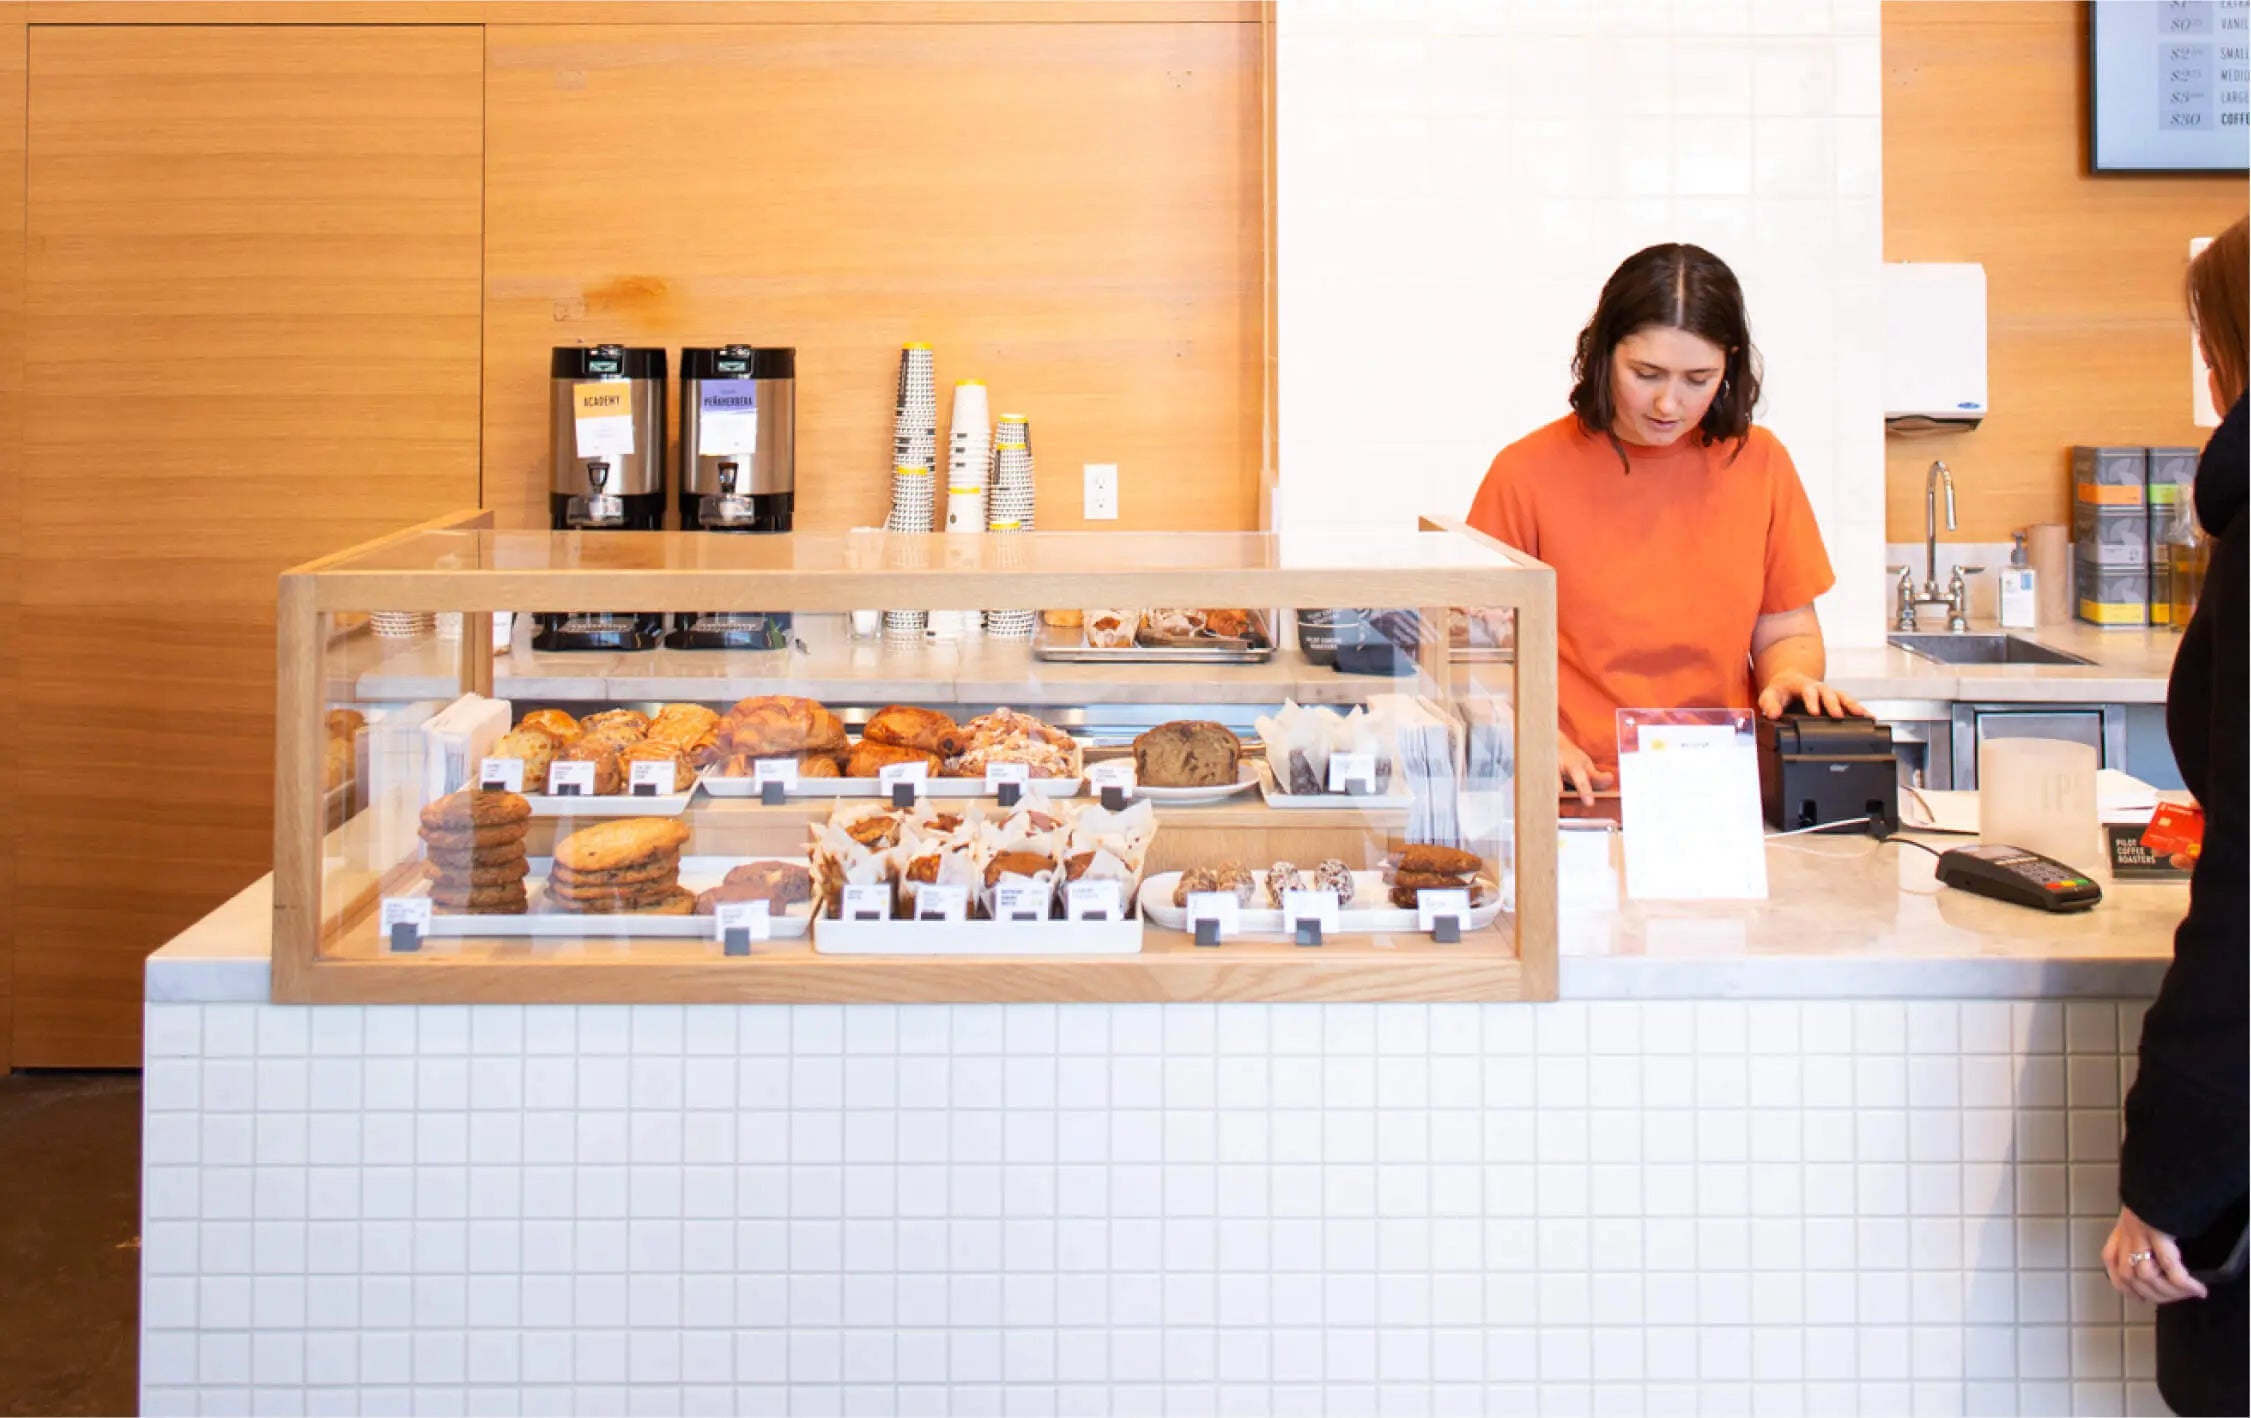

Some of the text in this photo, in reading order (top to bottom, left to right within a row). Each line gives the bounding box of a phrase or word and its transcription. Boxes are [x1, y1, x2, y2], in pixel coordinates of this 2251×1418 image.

[583, 395, 620, 407] ACADEMY
[2115, 838, 2137, 847] PILOT
[2117, 846, 2145, 857] COFFEE
[2118, 855, 2156, 865] ROASTERS
